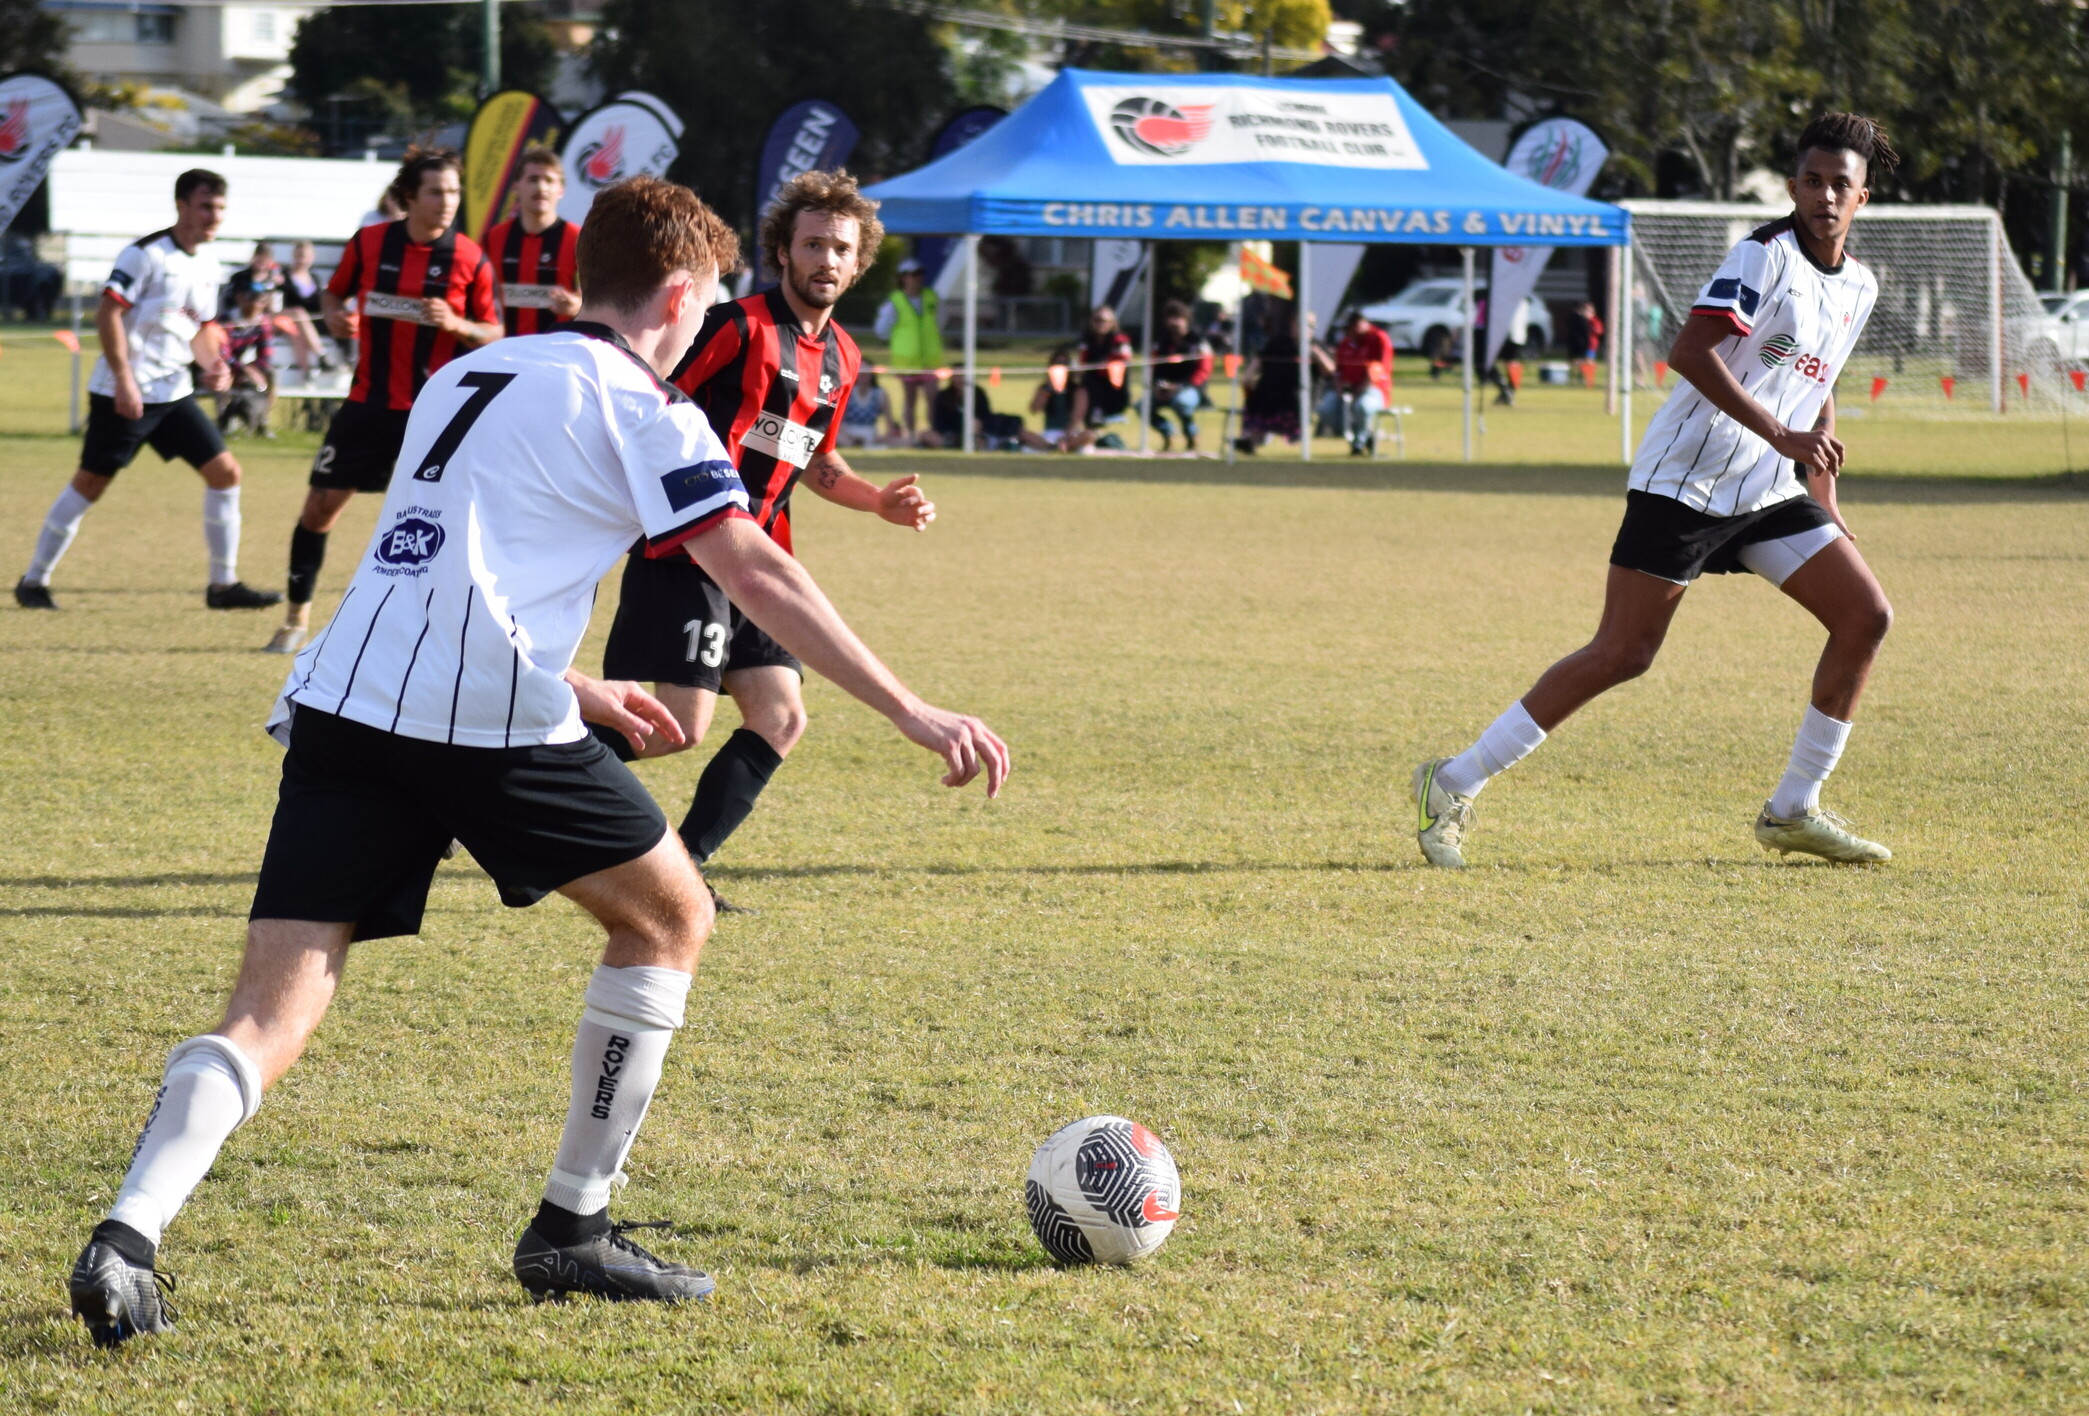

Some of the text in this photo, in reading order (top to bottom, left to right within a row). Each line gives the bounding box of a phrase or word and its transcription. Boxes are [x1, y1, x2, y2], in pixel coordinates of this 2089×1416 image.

[1229, 115, 1394, 137] RICHMOND ROVERS
[1343, 142, 1388, 156] CLUB
[1043, 203, 1609, 236] CHRIS ALLEN CANVAS & VINYL
[412, 370, 519, 483] 7
[683, 619, 726, 668] 13
[590, 1034, 631, 1120] ROVERS
